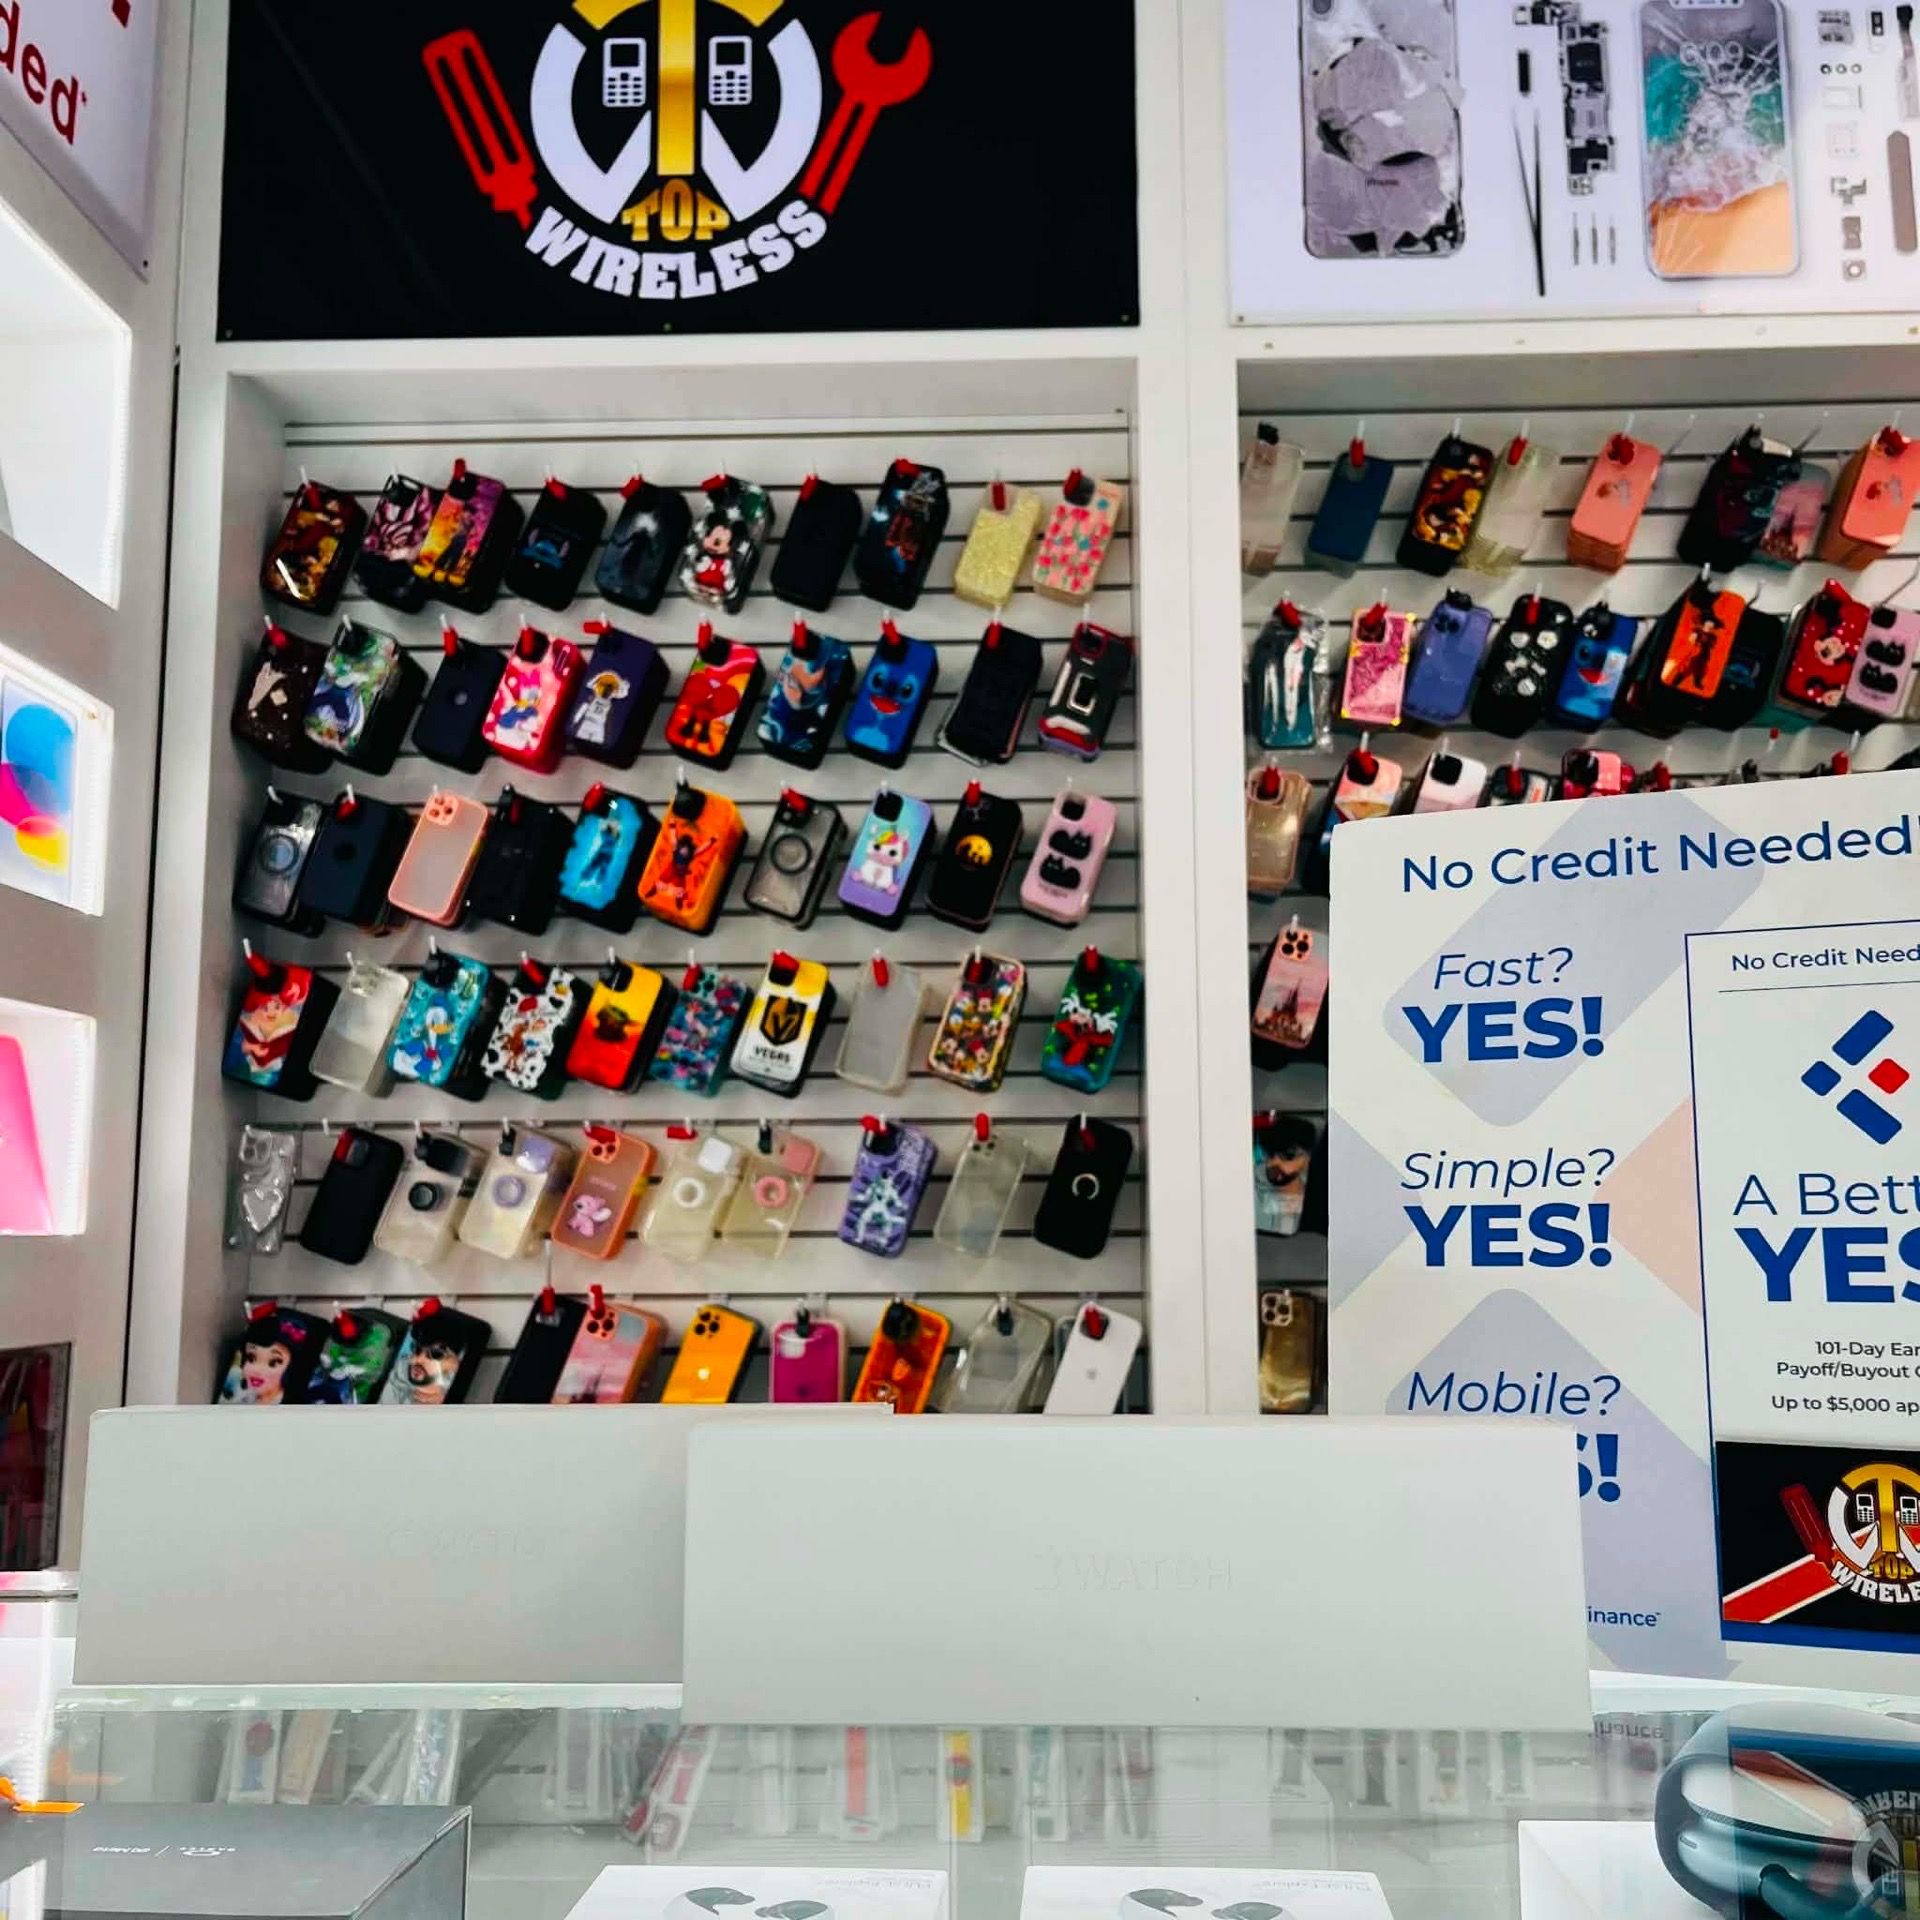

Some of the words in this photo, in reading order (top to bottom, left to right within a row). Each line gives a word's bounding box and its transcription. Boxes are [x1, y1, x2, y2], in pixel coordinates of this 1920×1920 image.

[621, 178, 731, 242] TOP
[524, 199, 828, 300] WIRELESS
[1403, 855, 1473, 893] No
[1491, 836, 1660, 885] Credit
[1680, 814, 1920, 872] Needed
[1433, 946, 1574, 990] Fast?
[1731, 954, 1765, 971] No
[1772, 948, 1849, 969] Credit
[1402, 997, 1605, 1063] YES!
[1400, 1147, 1615, 1198] Simple?
[1732, 1174, 1778, 1216] A
[1402, 1202, 1612, 1268] YES!
[1776, 1361, 1910, 1381] Payoff/Buyout
[1815, 1341, 1885, 1359] 101-Day
[1407, 1370, 1621, 1416] Mobile?
[1771, 1395, 1799, 1412] Up
[1803, 1397, 1822, 1410] to
[1826, 1395, 1891, 1413] $5,000
[1869, 1555, 1914, 1580] TOP
[1587, 1605, 1659, 1627] inance
